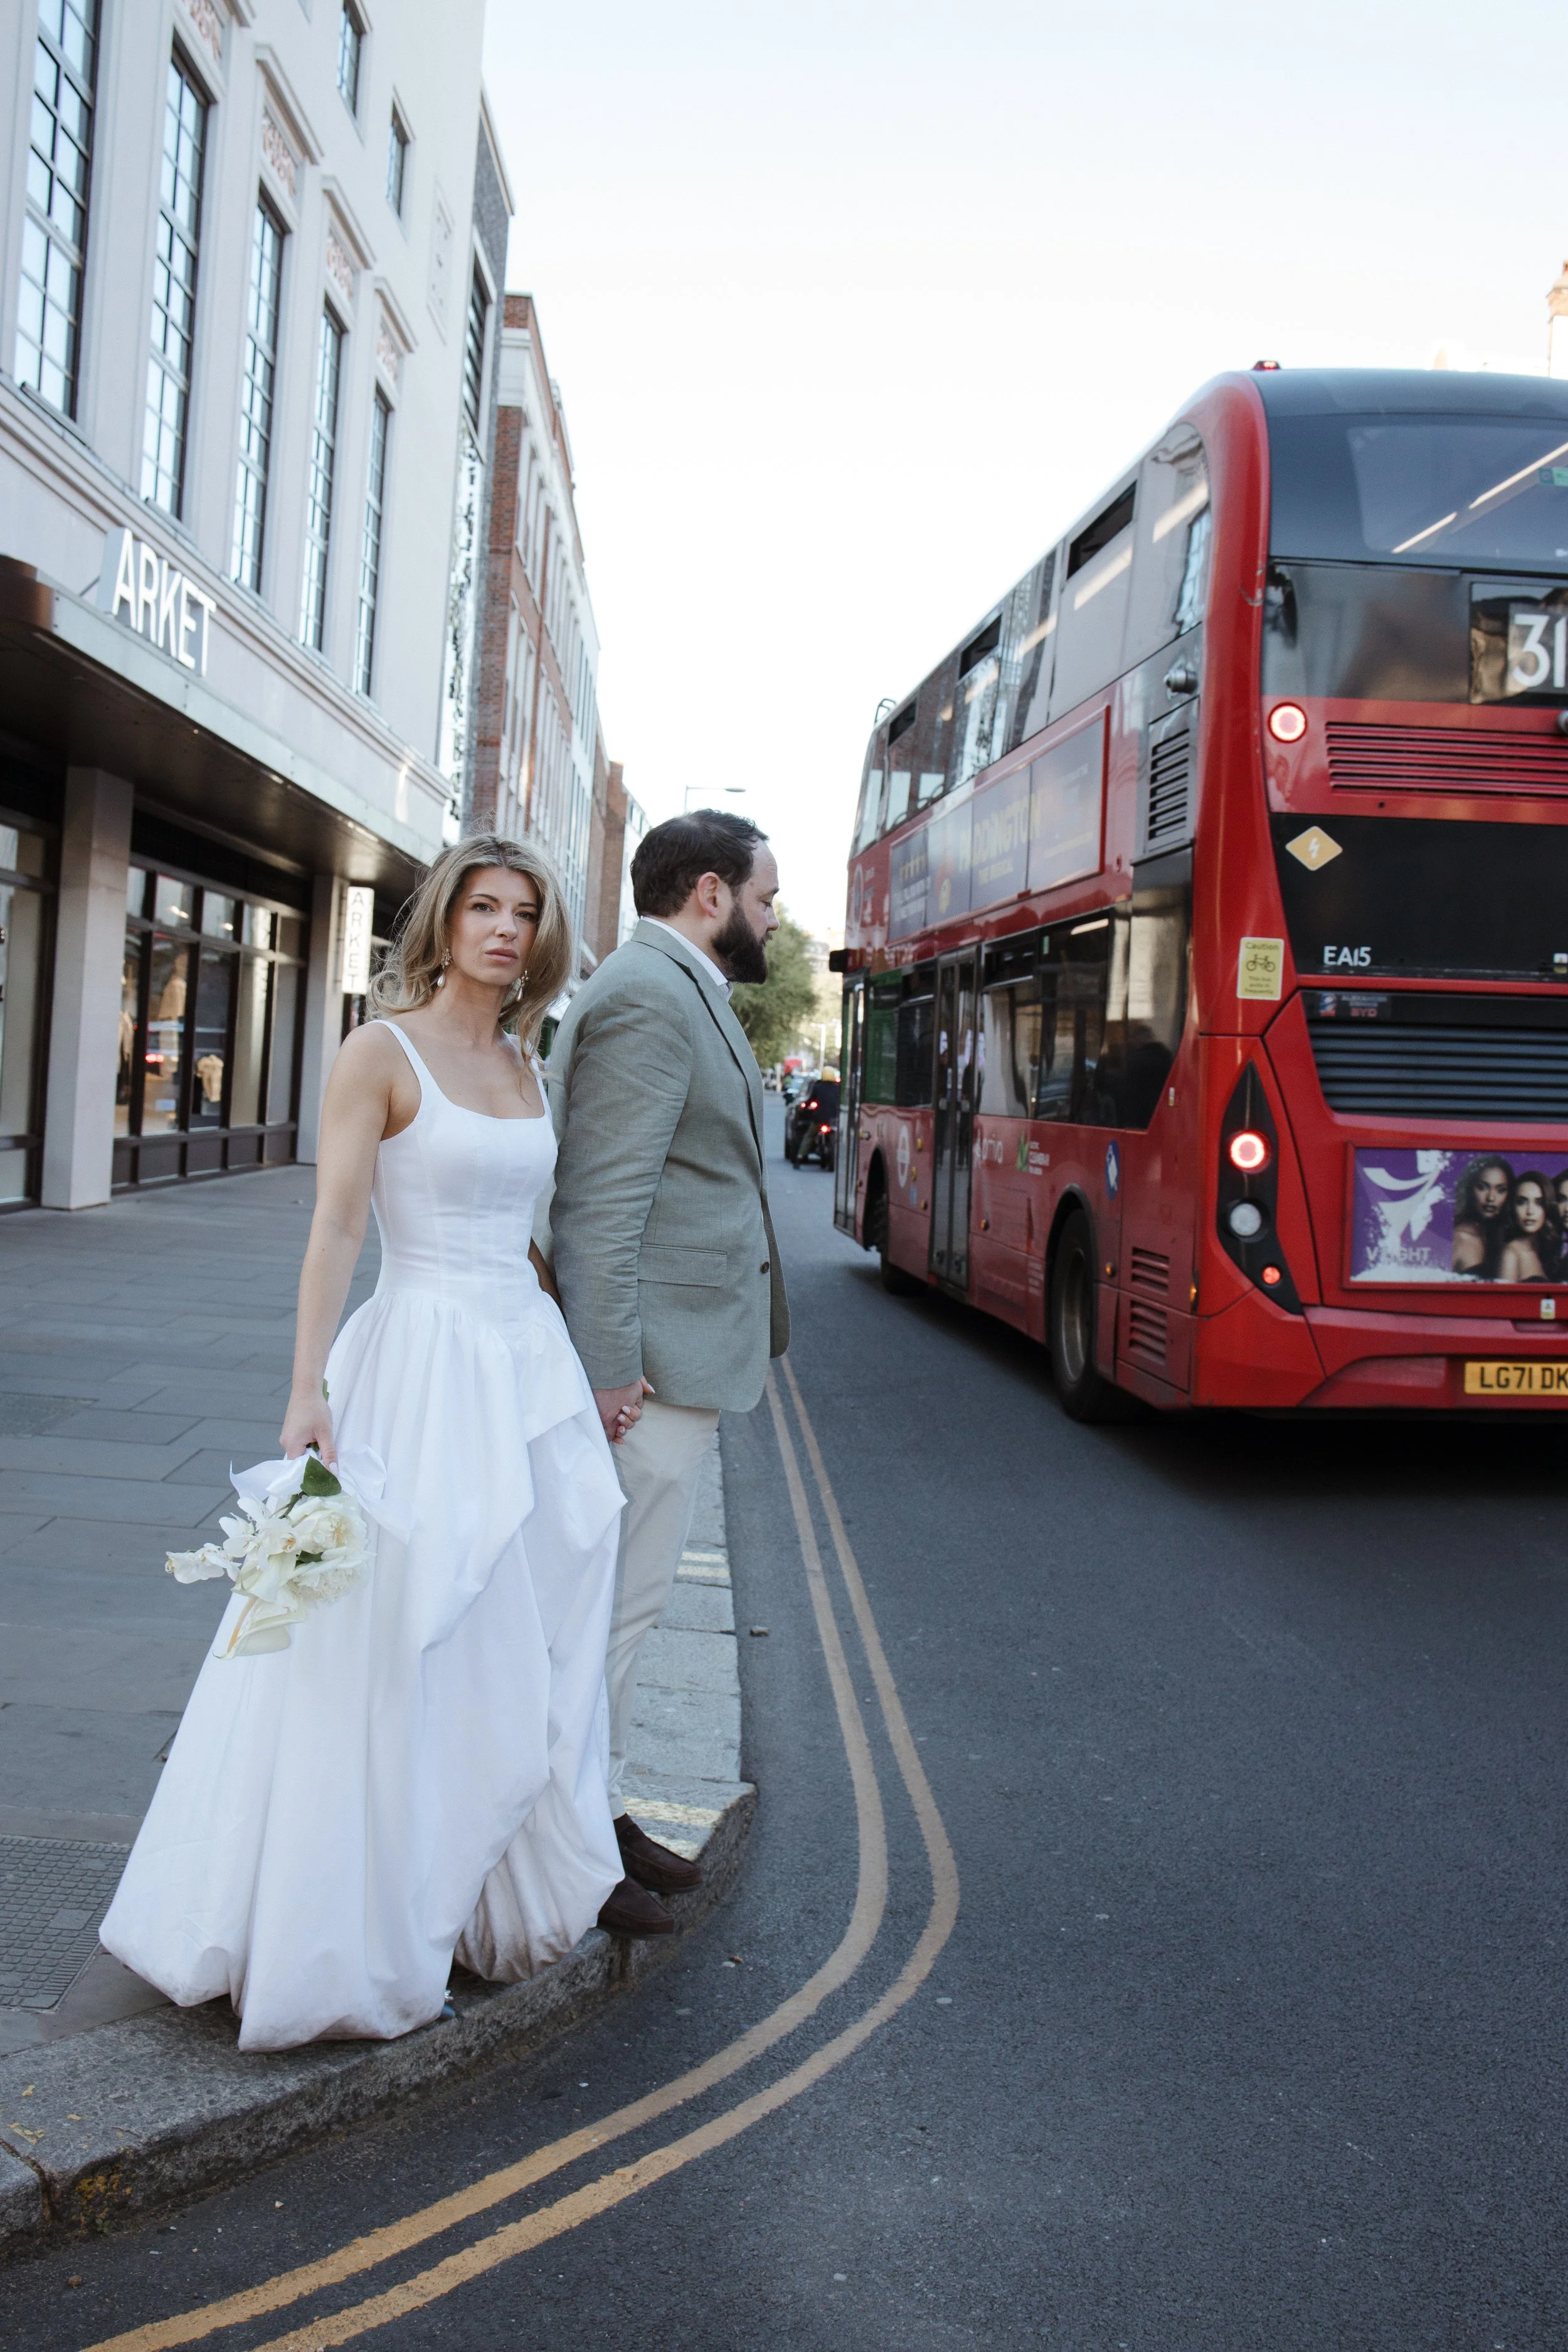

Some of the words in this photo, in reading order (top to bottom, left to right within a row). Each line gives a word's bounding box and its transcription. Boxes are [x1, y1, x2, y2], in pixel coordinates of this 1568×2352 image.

[112, 527, 216, 677] ARKET
[349, 892, 364, 988] ARKET
[1480, 1366, 1533, 1389] LG71
